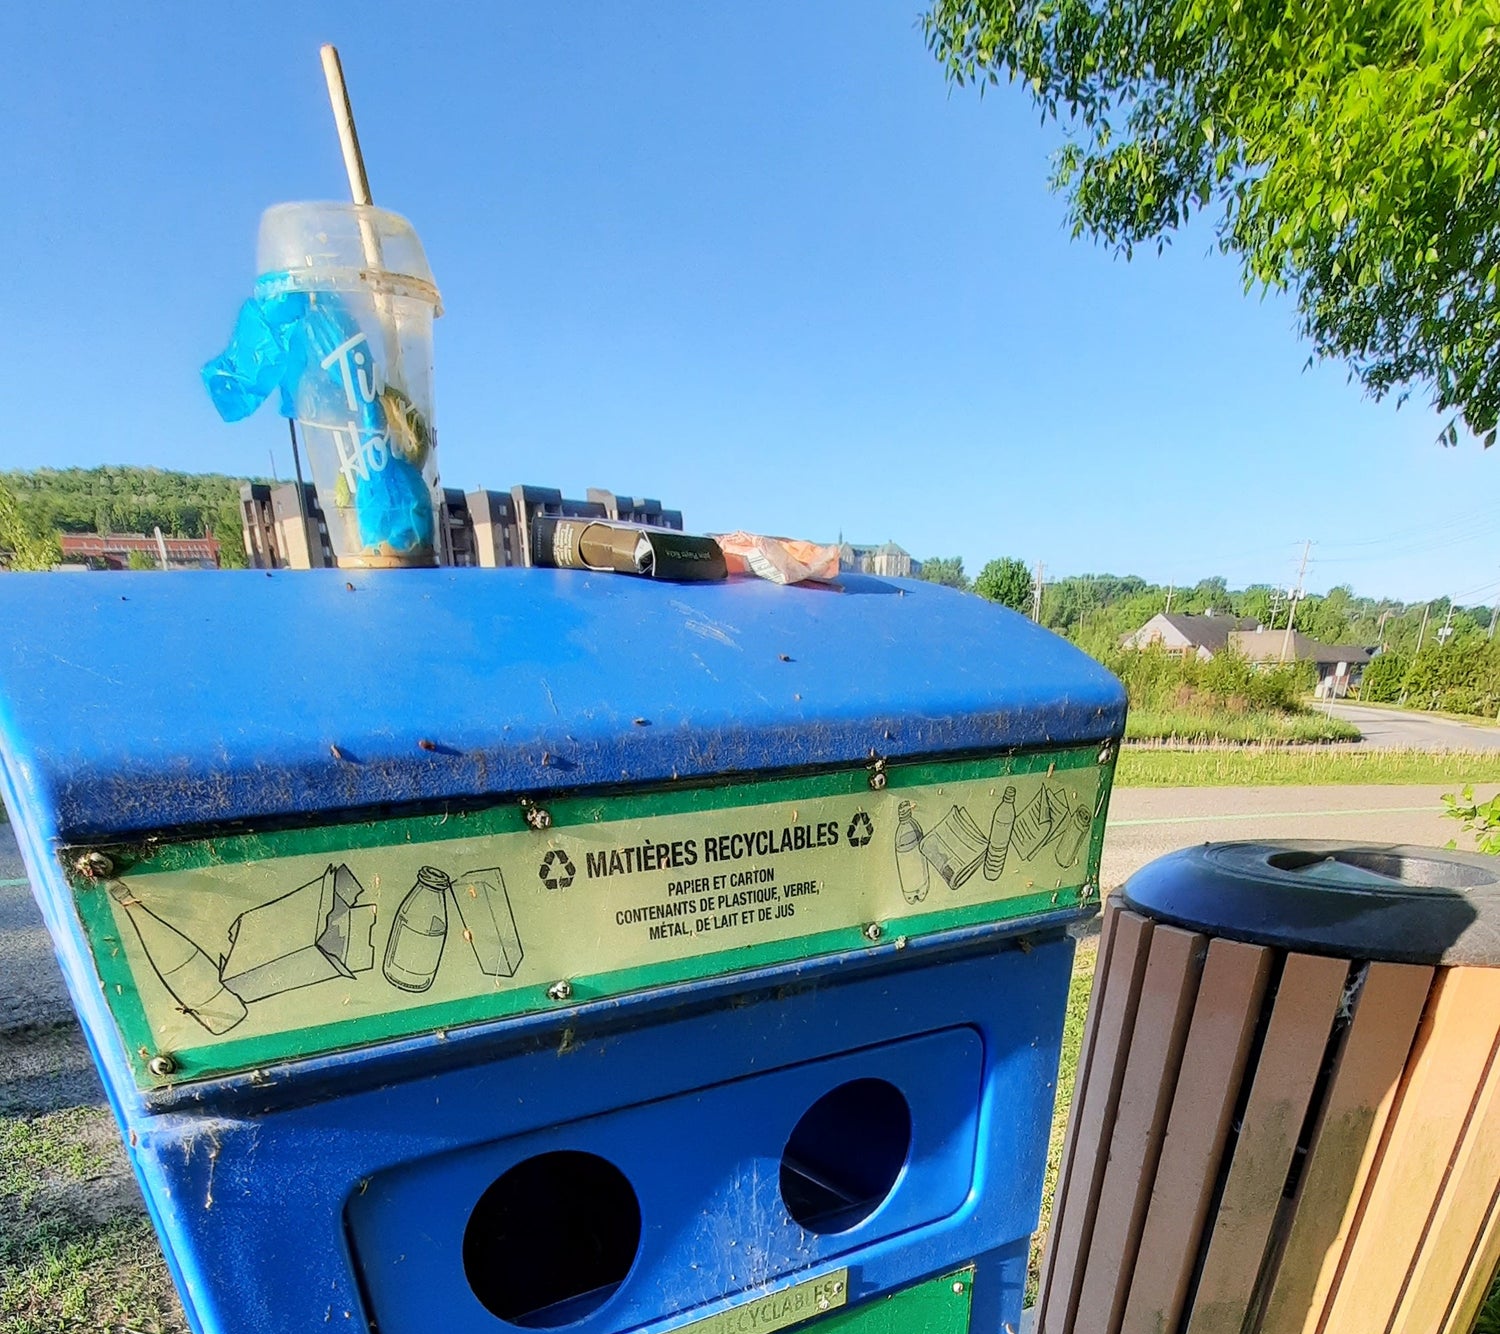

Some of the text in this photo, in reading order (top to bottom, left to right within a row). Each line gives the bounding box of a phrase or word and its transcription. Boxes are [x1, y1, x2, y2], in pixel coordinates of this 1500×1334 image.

[586, 821, 839, 879] MATIÈRES RECYCLABLES
[615, 880, 820, 926] CONTENANTS DE PLASTIQUE, VERRE,
[668, 868, 775, 897] PAPIER ET CARTON
[649, 903, 795, 940] MÉTAL, DE LAIT ET DE JUS
